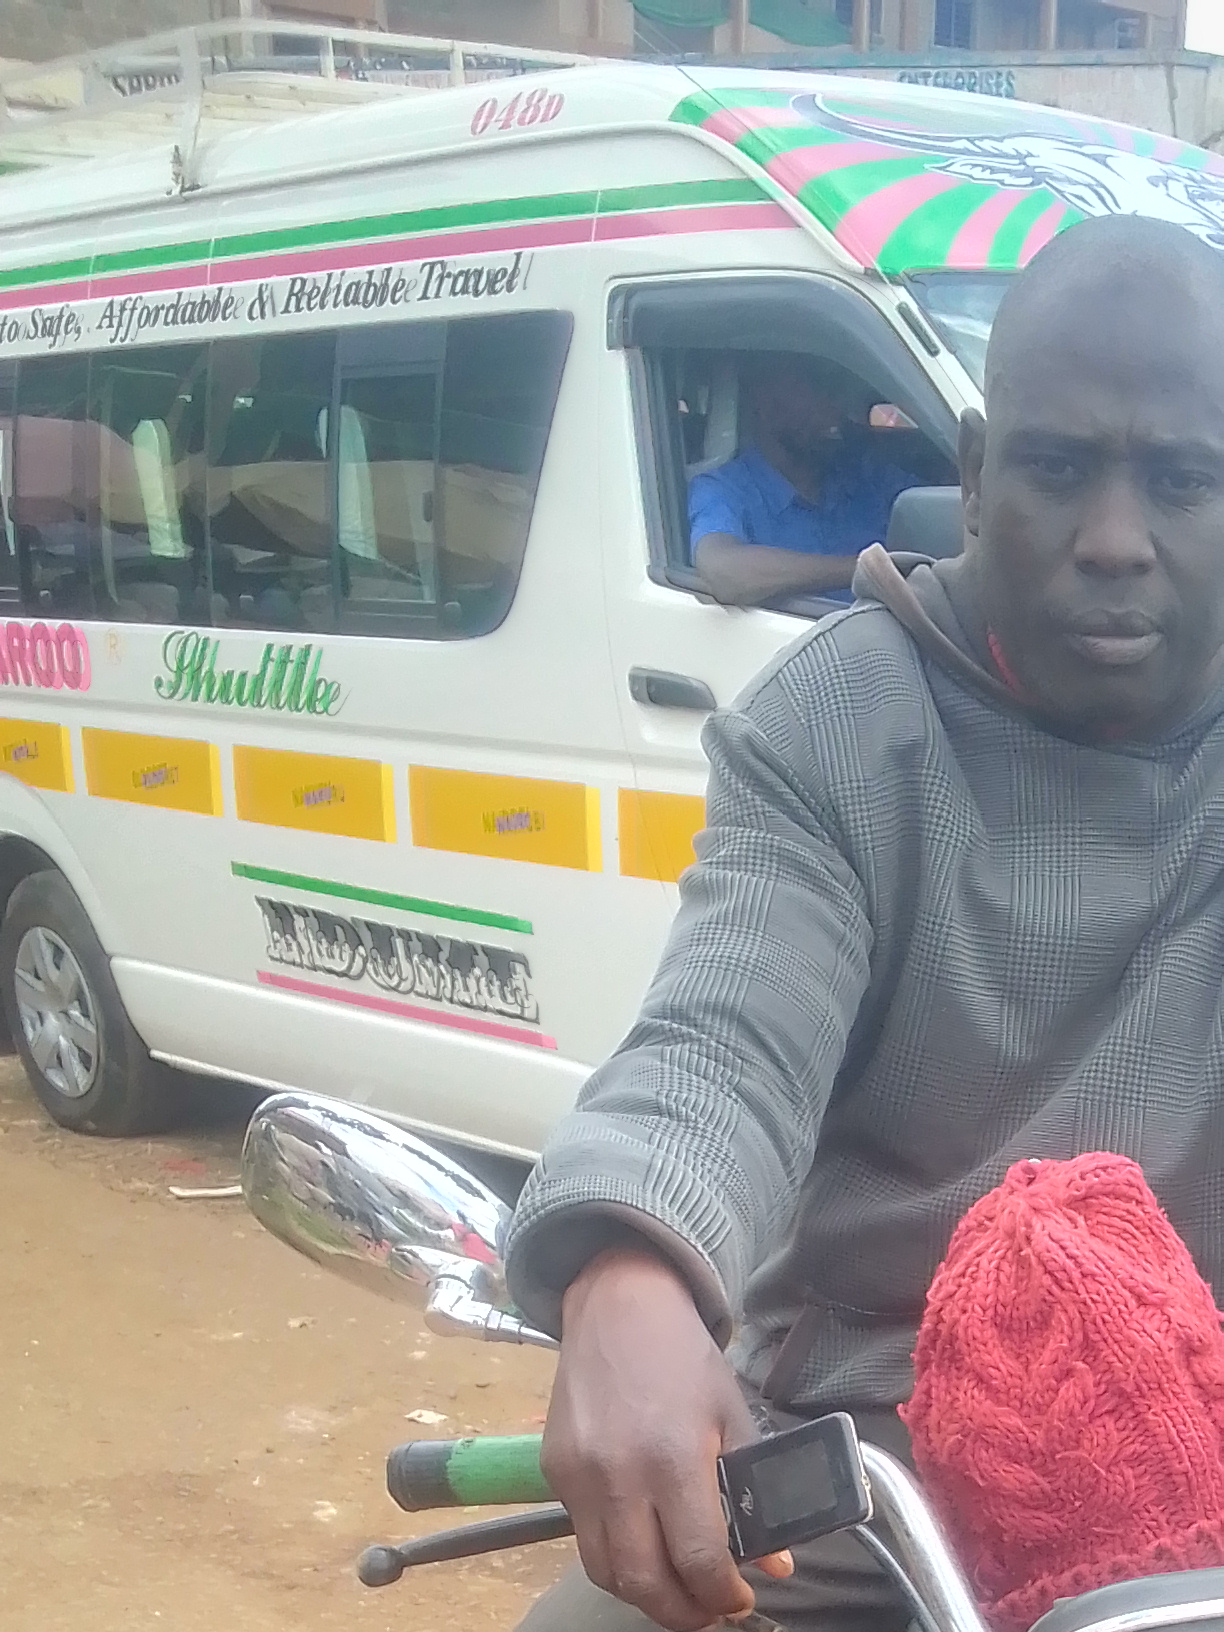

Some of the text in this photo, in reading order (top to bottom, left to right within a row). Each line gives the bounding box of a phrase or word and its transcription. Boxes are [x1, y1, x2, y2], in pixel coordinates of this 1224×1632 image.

[96, 286, 244, 343] Affordable
[280, 267, 418, 315] Reliable
[416, 250, 535, 302] Travel
[154, 629, 352, 717] Shuttle
